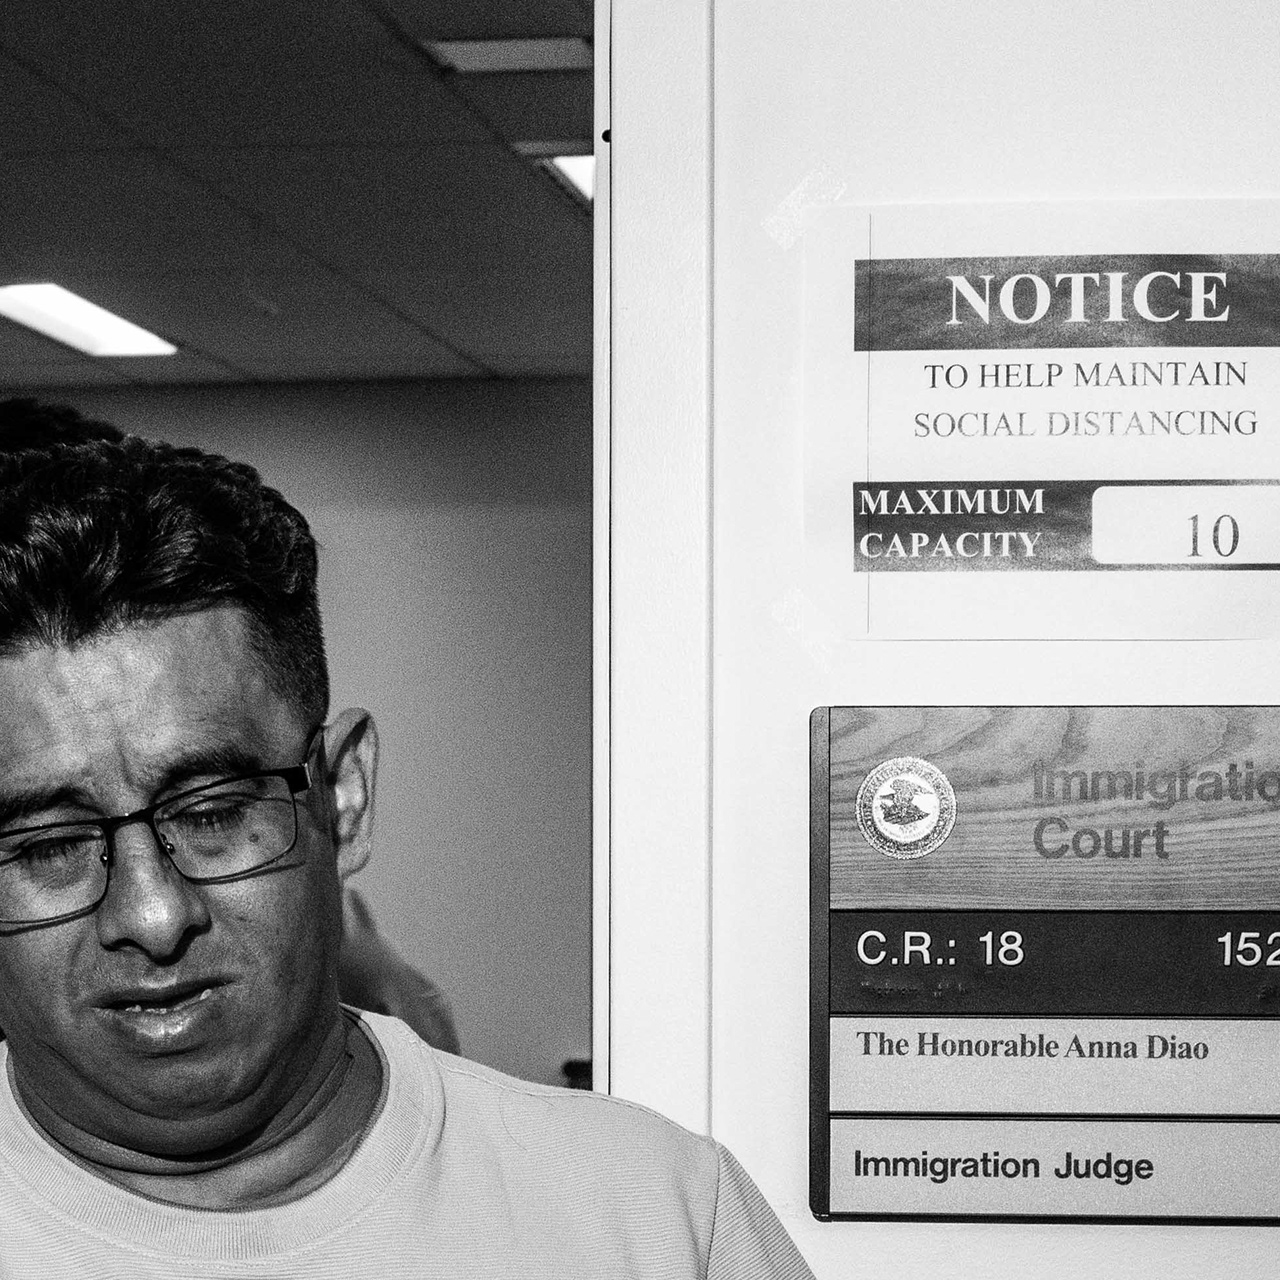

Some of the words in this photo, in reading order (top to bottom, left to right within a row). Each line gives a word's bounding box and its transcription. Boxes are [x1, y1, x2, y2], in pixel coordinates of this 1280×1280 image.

[945, 270, 1231, 325] NOTICE
[923, 363, 968, 388] TO
[979, 362, 1063, 388] HELP
[1074, 361, 1247, 386] MAINTAIN
[913, 411, 1034, 438] SOCIAL
[1047, 409, 1258, 436] DISTANCING
[858, 488, 1044, 514] MAXIMUM
[858, 532, 1042, 559] CAPACITY
[1186, 514, 1240, 558] 10
[1033, 812, 1170, 860] Court
[857, 930, 955, 964] C.R.:
[979, 930, 1023, 965] 18
[856, 1031, 909, 1056] The
[917, 1032, 1059, 1058] Honorable
[1064, 1034, 1137, 1058] Anna
[1147, 1034, 1208, 1059] Diao
[854, 1150, 1040, 1184] Immigration
[1054, 1152, 1154, 1185] Judge
